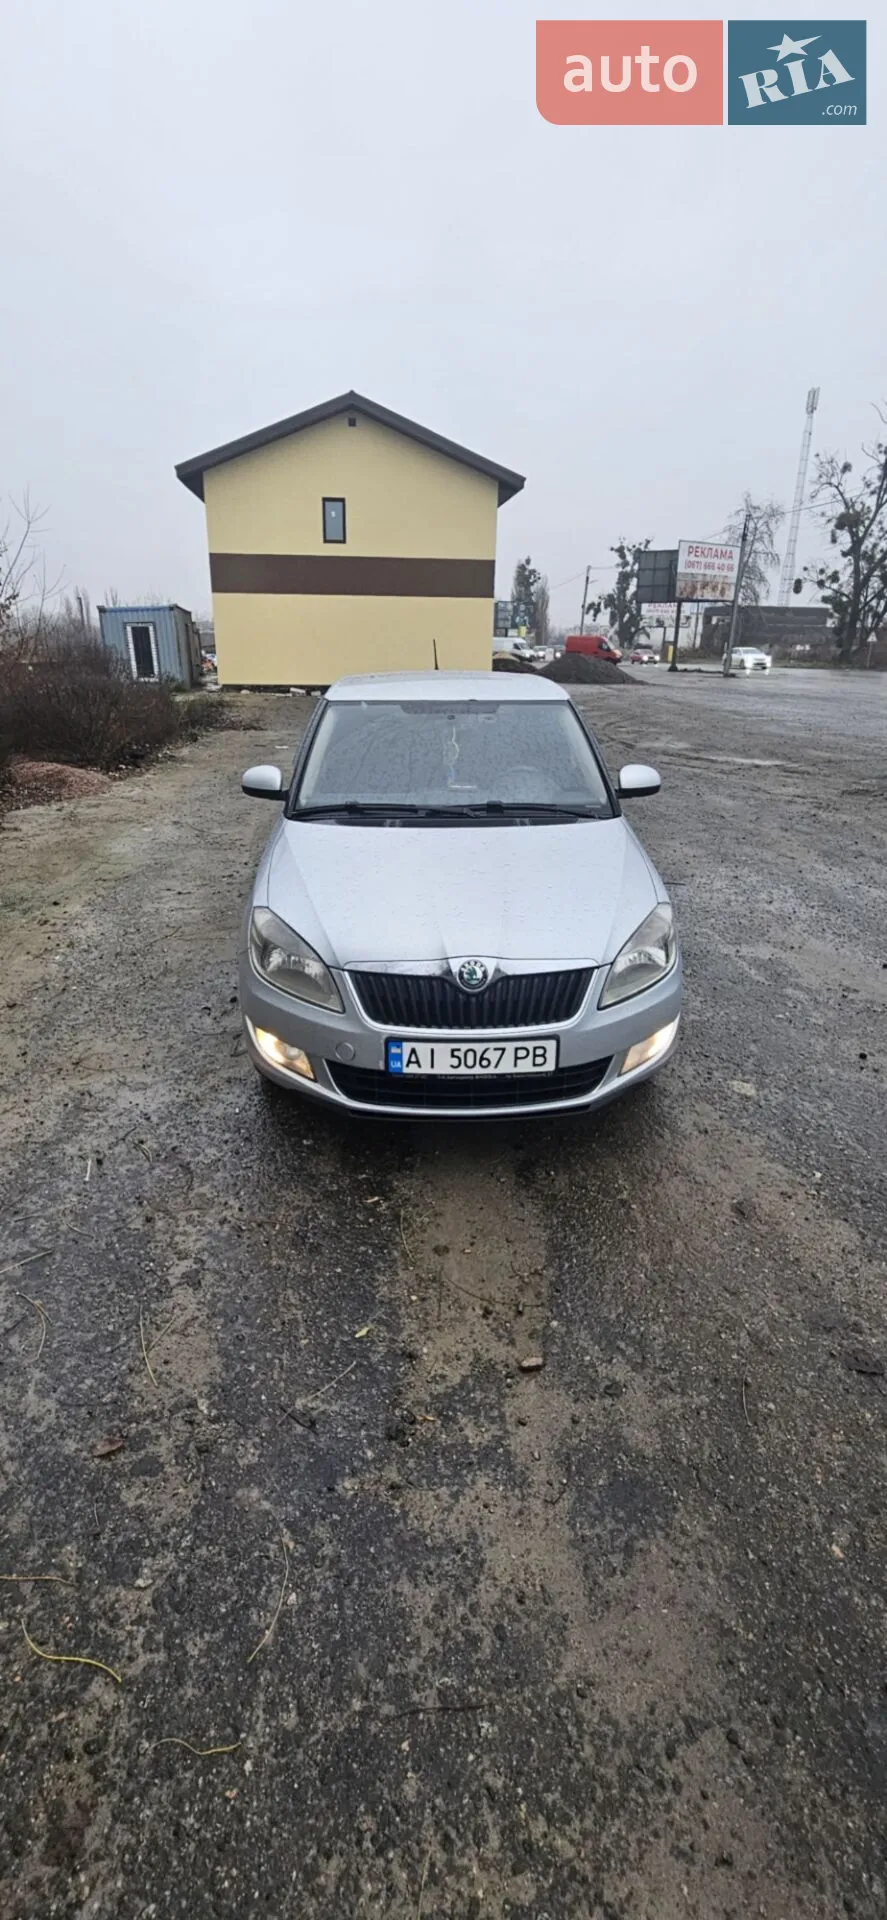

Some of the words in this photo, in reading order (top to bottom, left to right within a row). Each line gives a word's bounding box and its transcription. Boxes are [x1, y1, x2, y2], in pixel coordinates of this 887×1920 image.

[687, 545, 733, 560] РЕКЛАМА
[390, 1061, 402, 1069] UA
[405, 1047, 435, 1069] AI
[449, 1047, 507, 1069] 5067
[513, 1046, 548, 1068] PB
